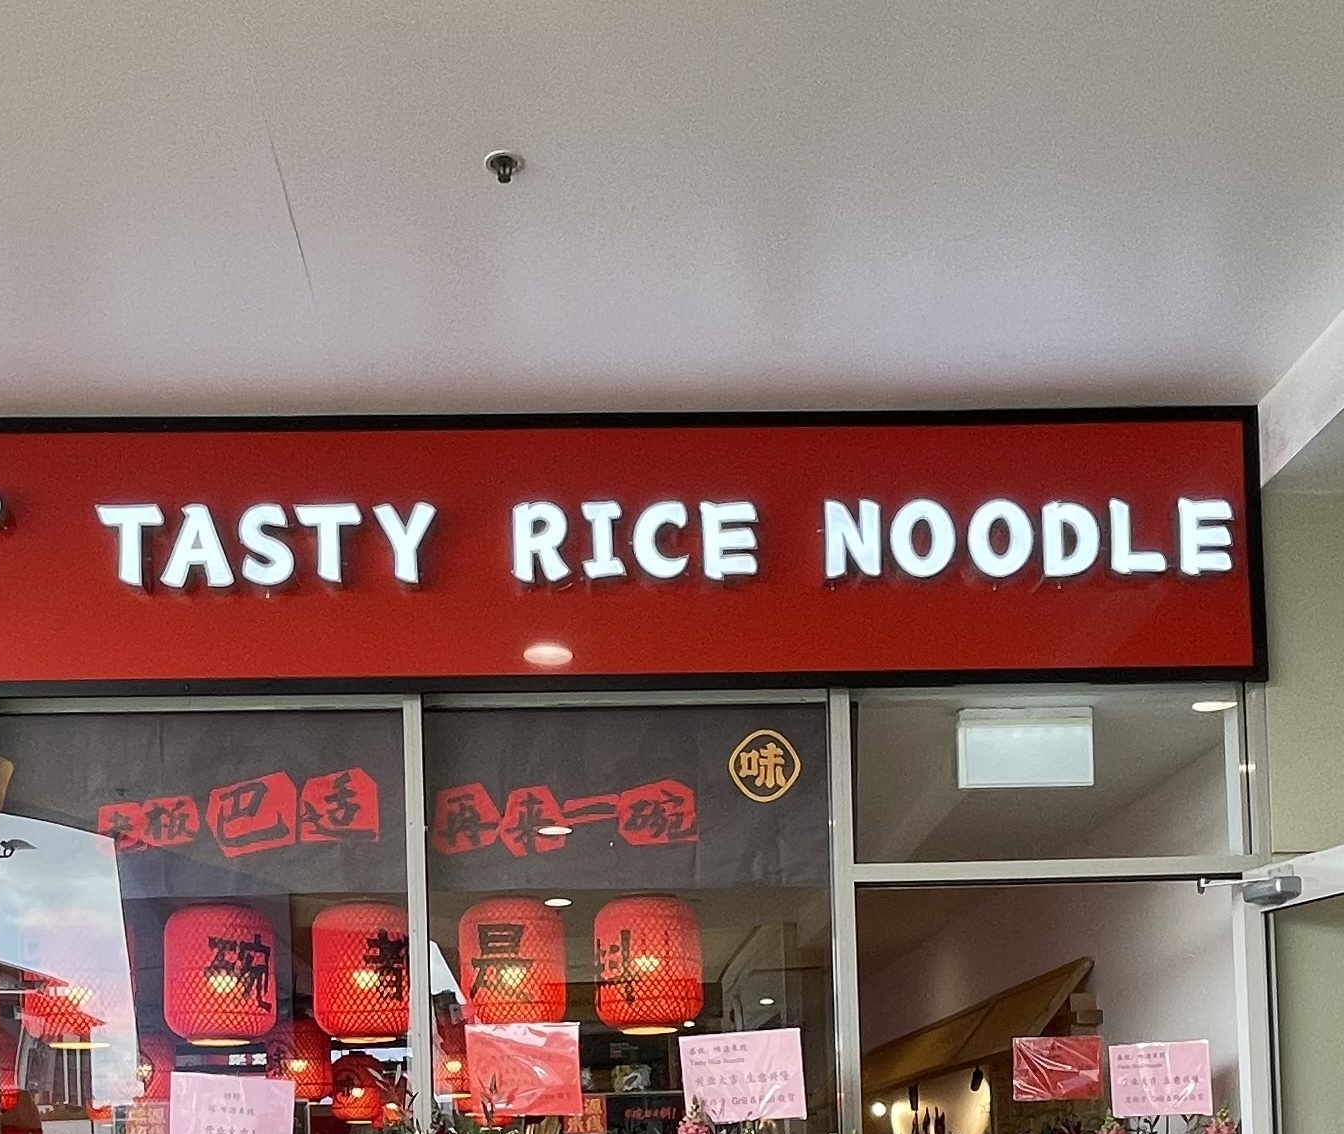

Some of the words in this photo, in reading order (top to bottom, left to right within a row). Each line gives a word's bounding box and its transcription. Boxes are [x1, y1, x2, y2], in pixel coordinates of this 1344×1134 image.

[94, 502, 437, 588] TASTY
[512, 500, 758, 583] RICE
[823, 498, 1234, 579] NOODLE
[738, 742, 789, 790] 味
